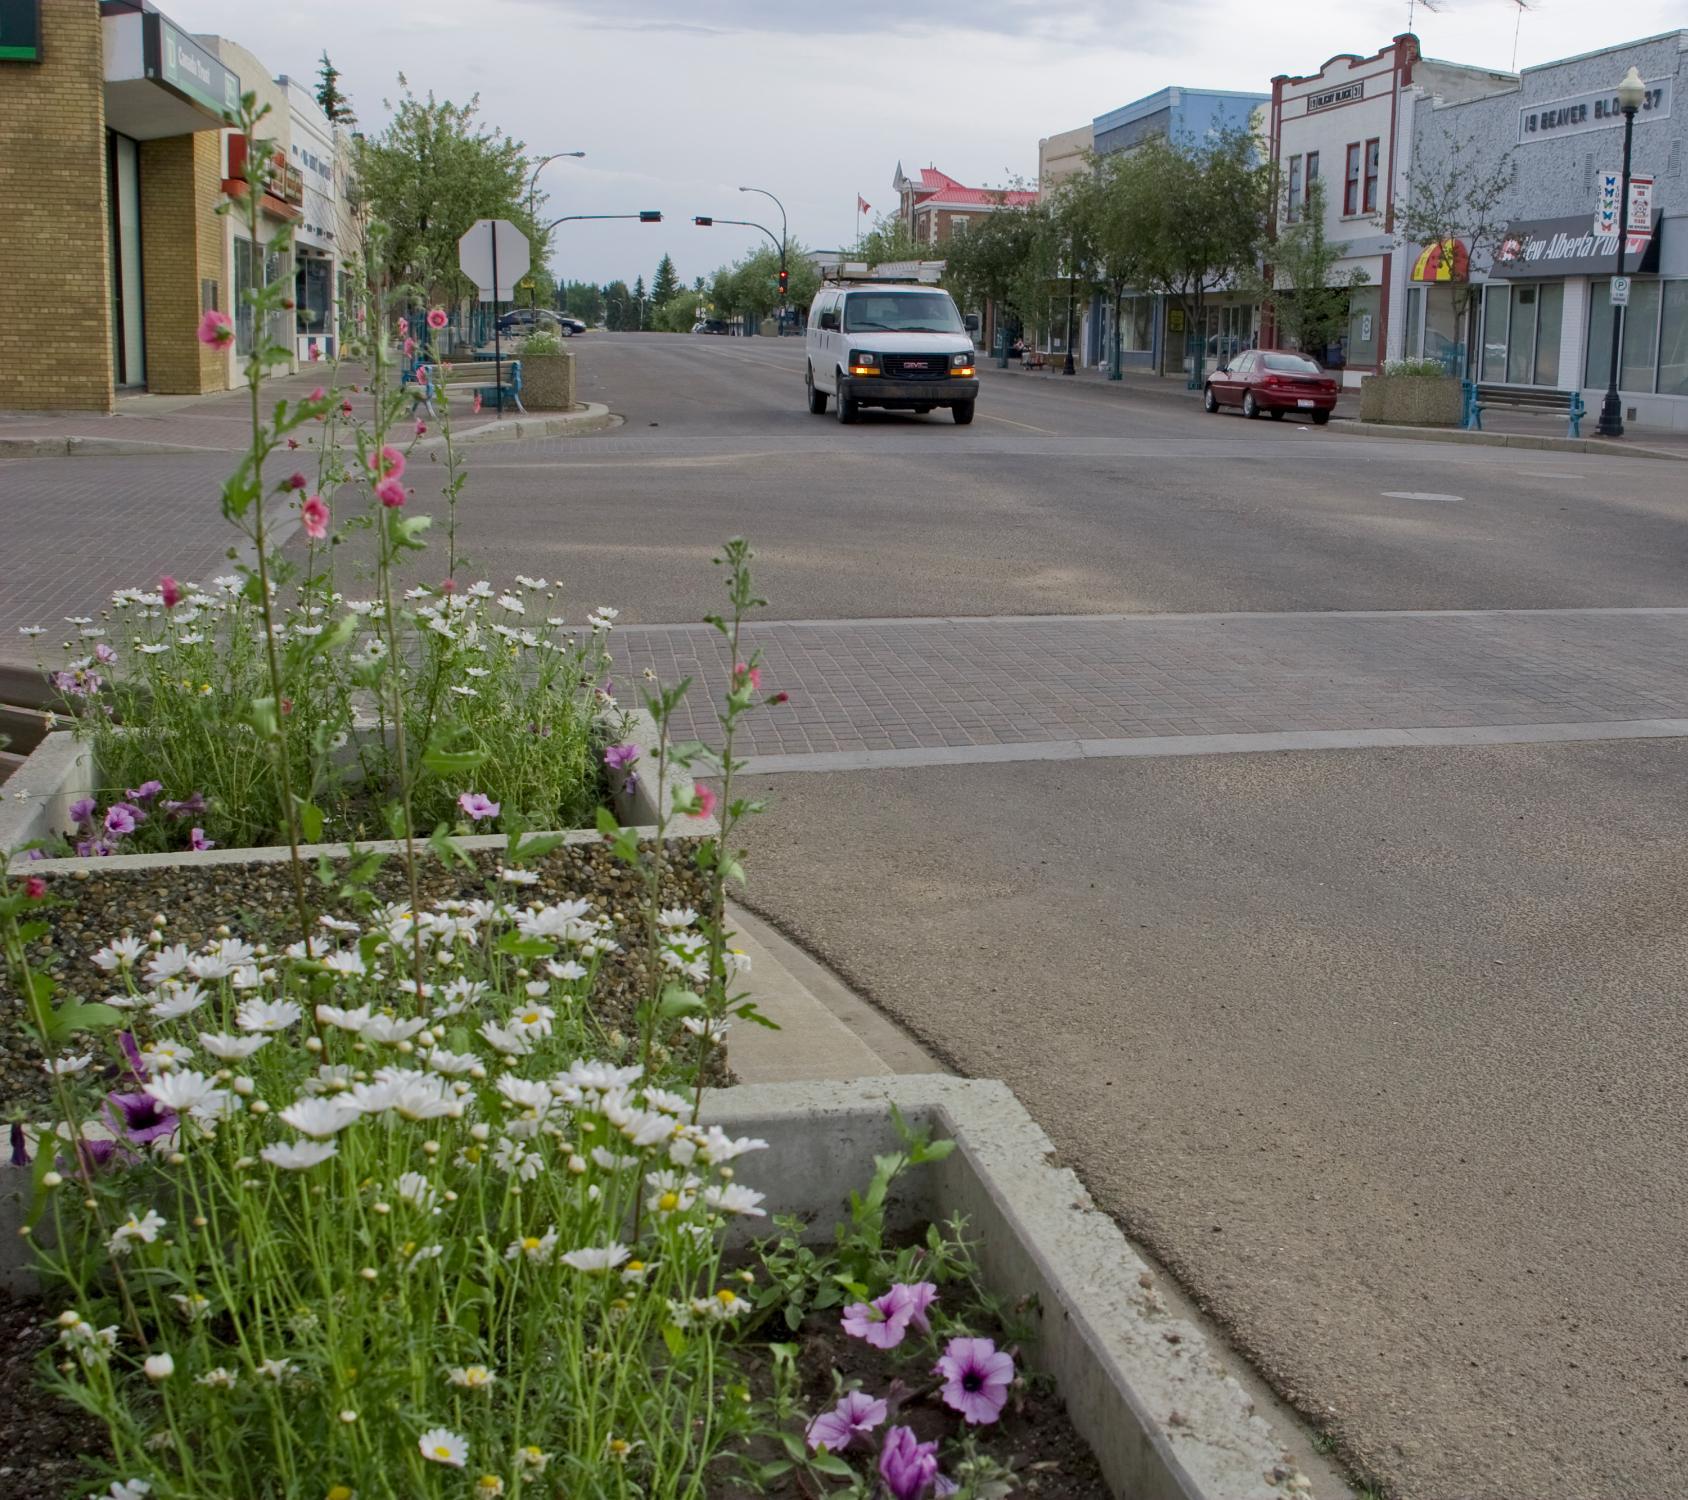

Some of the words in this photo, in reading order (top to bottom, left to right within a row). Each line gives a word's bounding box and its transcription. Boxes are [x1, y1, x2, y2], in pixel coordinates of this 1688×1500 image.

[1524, 113, 1537, 132] 19
[1540, 104, 1587, 130] BEAVER
[1594, 97, 1621, 119] BLO
[1643, 88, 1662, 110] 37
[1543, 230, 1593, 259] Alberta
